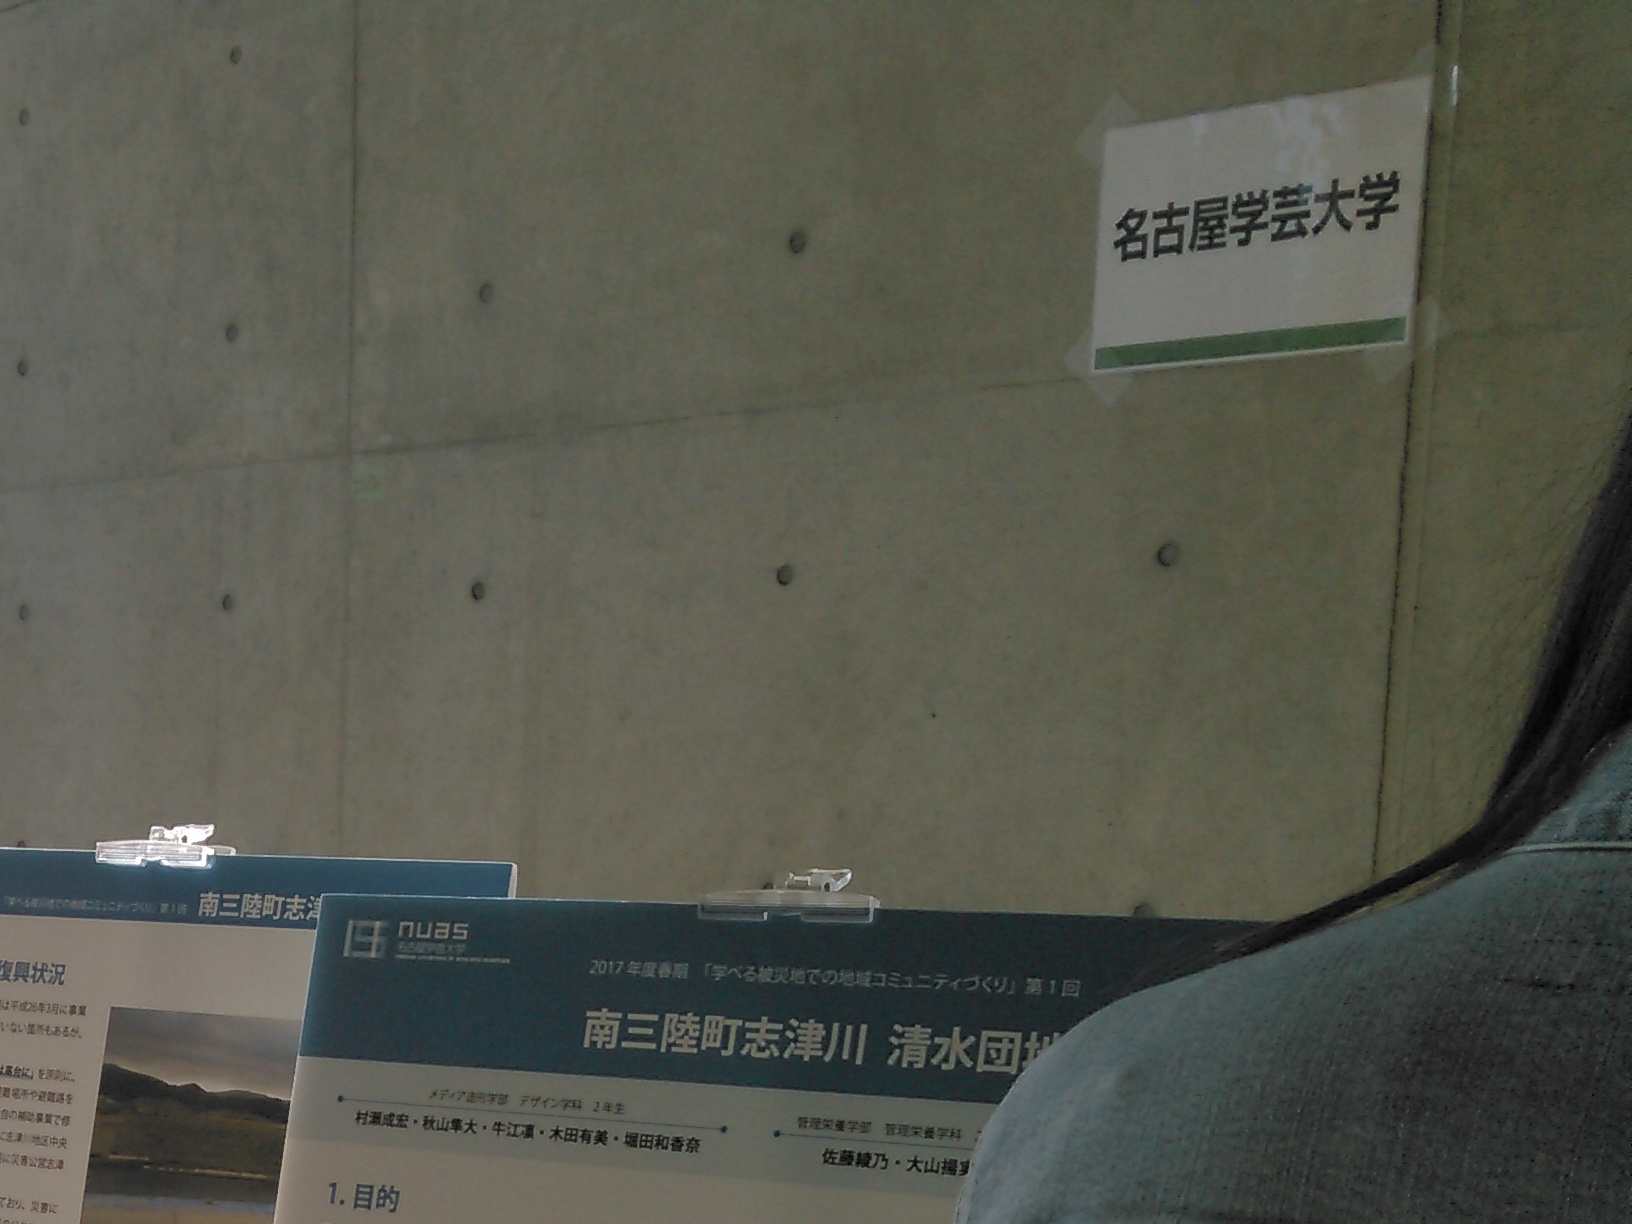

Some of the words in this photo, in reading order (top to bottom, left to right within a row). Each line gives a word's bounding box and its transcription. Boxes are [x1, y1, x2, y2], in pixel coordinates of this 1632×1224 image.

[1113, 171, 1401, 262] 名古屋学芸大学
[398, 921, 469, 940] nuas
[584, 1008, 868, 1066] 南三陸町志津川
[798, 1117, 872, 1135] 管理栄養学部
[885, 1123, 962, 1142] 管理栄養学科
[328, 1181, 345, 1206] 1.
[353, 1183, 401, 1213] 目的
